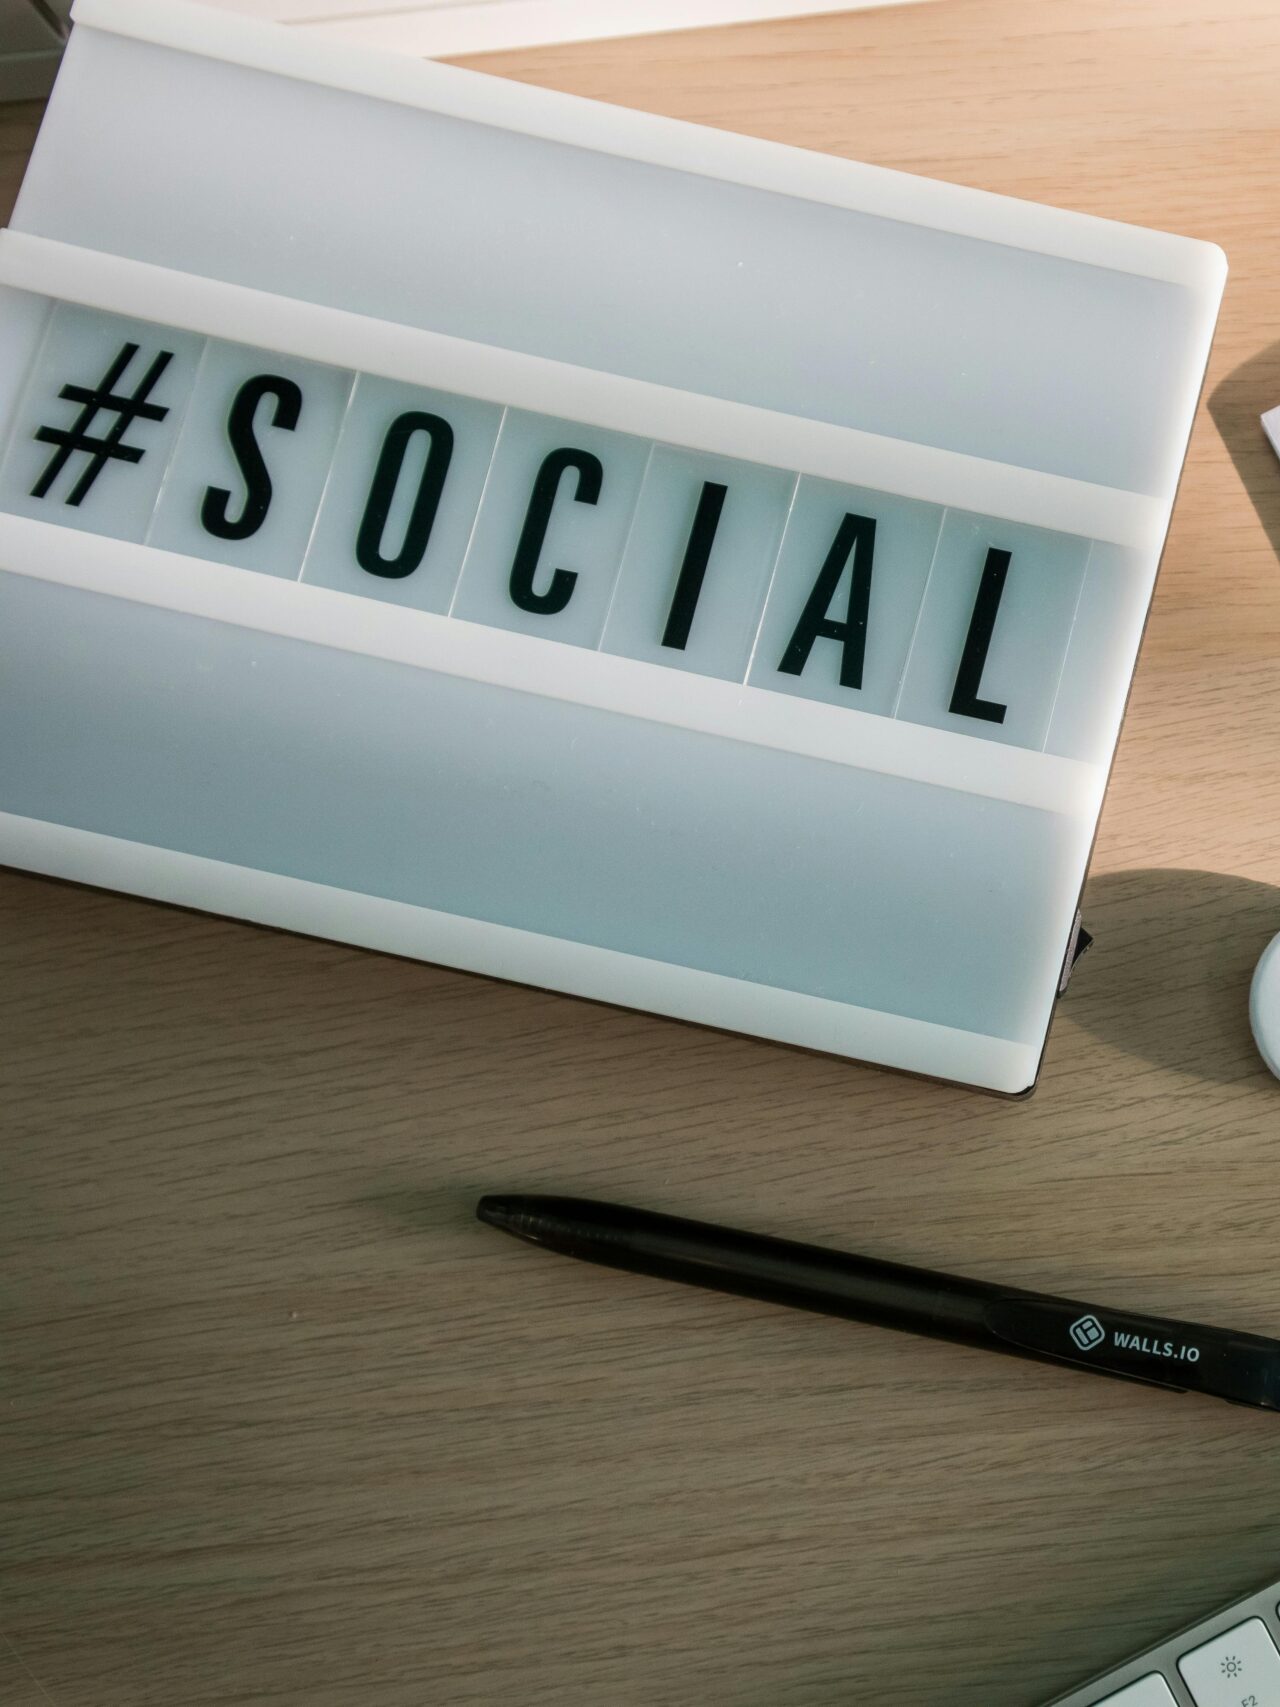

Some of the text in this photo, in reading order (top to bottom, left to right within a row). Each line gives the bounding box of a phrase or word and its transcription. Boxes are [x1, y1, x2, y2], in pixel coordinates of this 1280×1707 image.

[30, 342, 1013, 724] #SOCIAL
[1114, 1331, 1200, 1362] WALLS.IO
[1240, 1695, 1259, 1707] F2
